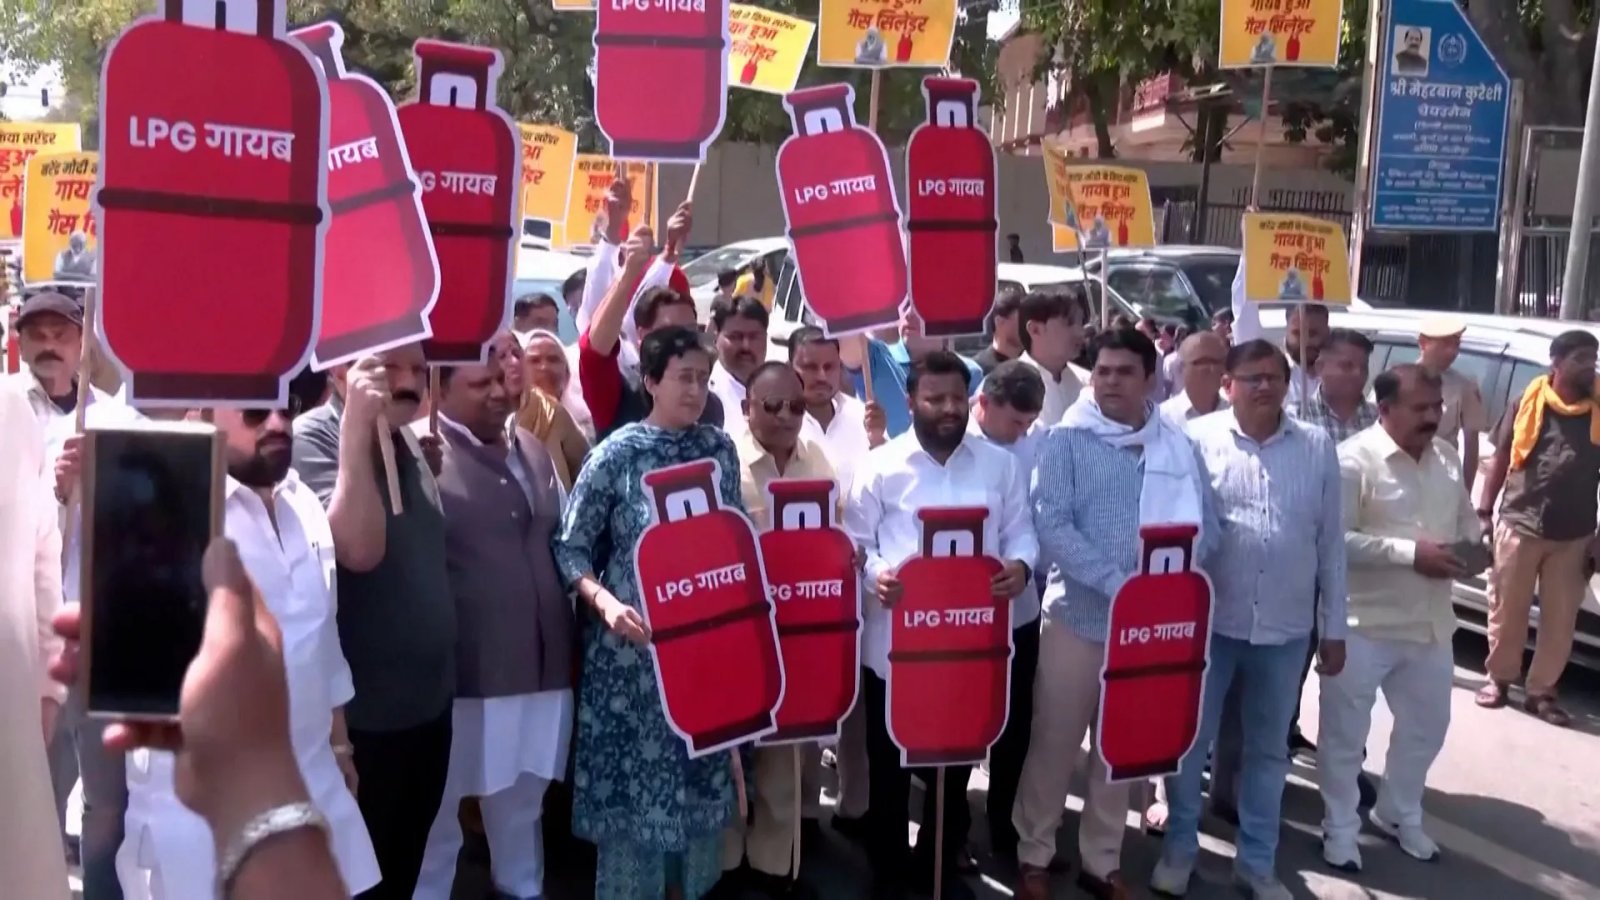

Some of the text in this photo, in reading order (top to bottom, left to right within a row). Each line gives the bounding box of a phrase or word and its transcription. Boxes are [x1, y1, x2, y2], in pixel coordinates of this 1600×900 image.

[876, 9, 929, 32] सिलेंडर
[23, 130, 57, 145] सरेंडर
[129, 115, 296, 163] LPG गायब
[55, 180, 96, 201] गाय
[440, 171, 498, 197] गायब
[795, 174, 876, 205] LPG गायब
[918, 177, 985, 198] LPG गायब
[656, 563, 746, 604] LPG गायब
[795, 580, 844, 599] गायब
[904, 607, 995, 628] LPG गायब
[1120, 621, 1196, 646] LPG गायब
